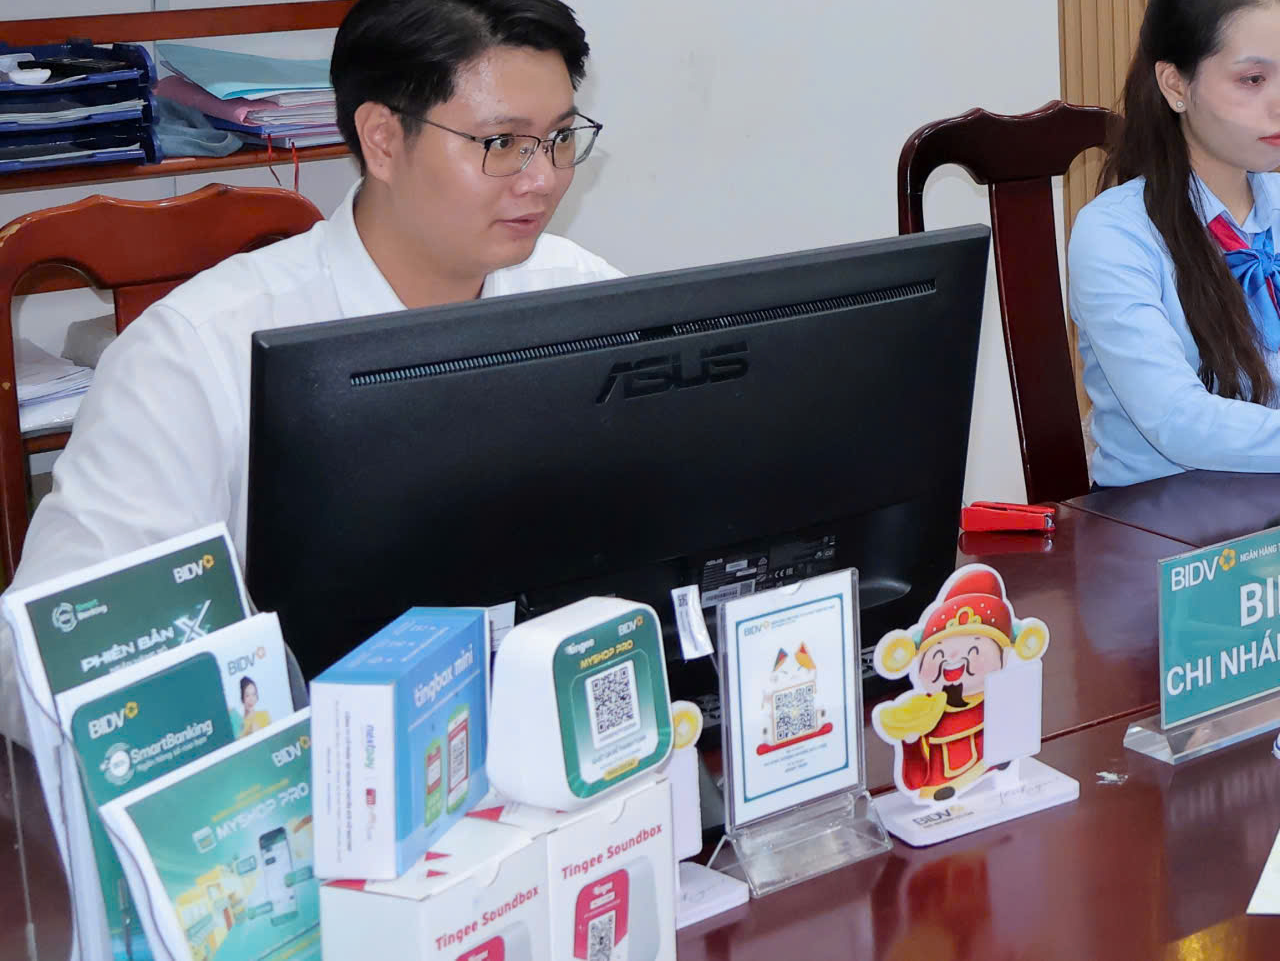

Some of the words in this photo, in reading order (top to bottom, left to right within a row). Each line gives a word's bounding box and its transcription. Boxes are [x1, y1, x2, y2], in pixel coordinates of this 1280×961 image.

[595, 341, 749, 404] ASUS
[1239, 548, 1259, 563] NGÂN
[1259, 543, 1278, 557] HÀNG
[173, 558, 205, 584] BIDV
[1171, 556, 1220, 592] BIDV
[80, 640, 136, 673] PHIÊN
[137, 626, 175, 651] BẢN
[227, 651, 255, 676] BIDV
[579, 648, 615, 670] MYSHOP
[615, 639, 634, 655] PRO
[414, 663, 454, 708] tingbox
[455, 642, 473, 677] mini
[1166, 655, 1212, 696] CHI
[88, 707, 126, 740] BIDV
[130, 719, 214, 764] SmartBanking
[271, 741, 302, 768] BIDV
[277, 781, 310, 807] PRO
[911, 808, 951, 826] BIDV
[560, 853, 604, 880] Tingee
[606, 823, 663, 859] Soundbox
[435, 920, 478, 951] Tingee
[481, 886, 539, 927] Soundbox
